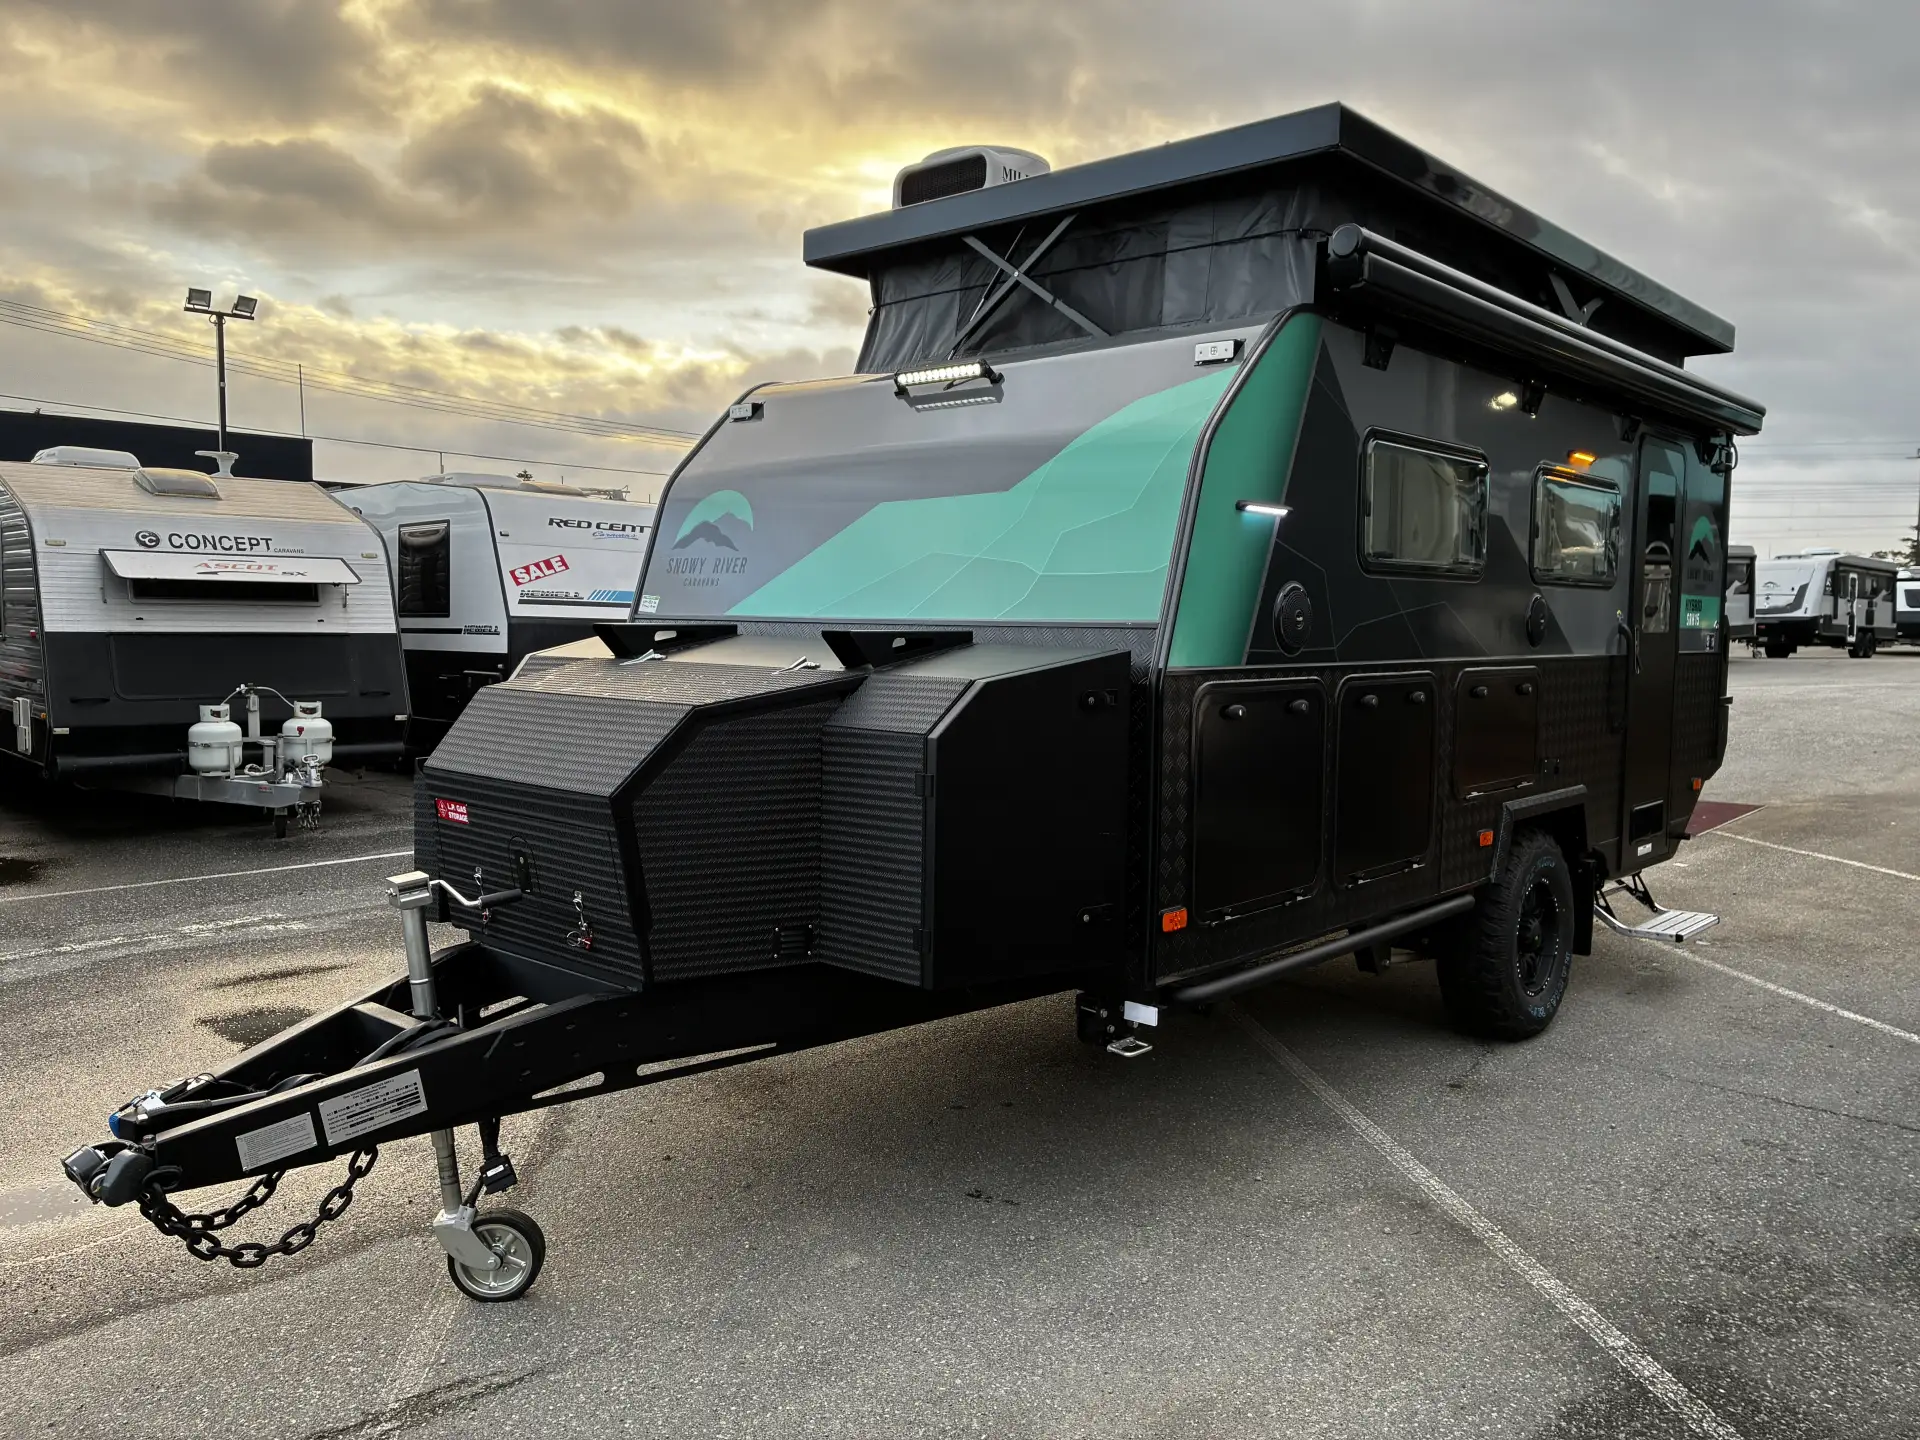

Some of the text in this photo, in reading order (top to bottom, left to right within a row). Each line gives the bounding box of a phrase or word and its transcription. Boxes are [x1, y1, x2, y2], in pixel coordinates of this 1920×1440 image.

[548, 517, 592, 529] RED
[168, 532, 273, 552] CONCEPT
[194, 562, 279, 571] ASCOT
[514, 557, 566, 584] SALE
[666, 557, 748, 574] SNOWY RIVER
[683, 578, 720, 587] CARAVANS
[456, 805, 467, 813] GAS
[448, 812, 469, 822] STORAGE
